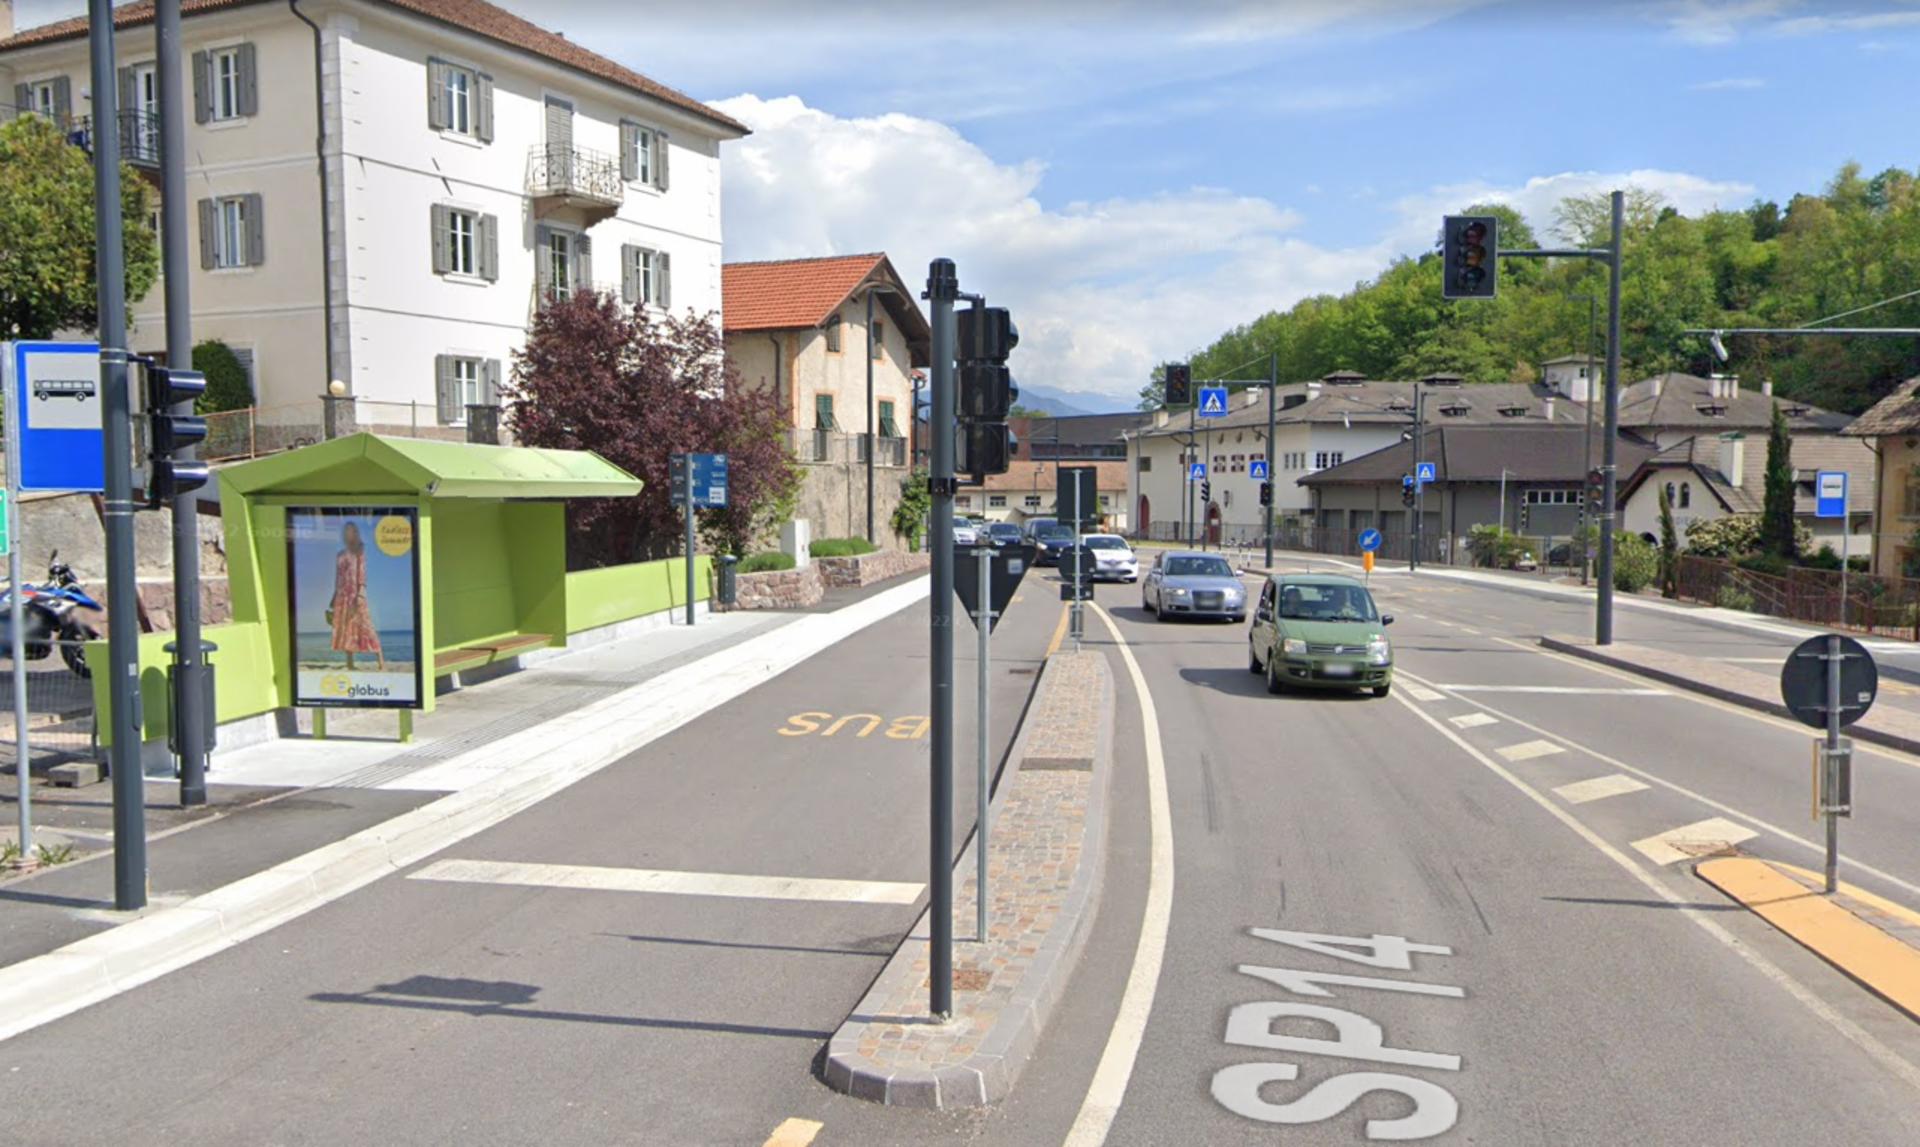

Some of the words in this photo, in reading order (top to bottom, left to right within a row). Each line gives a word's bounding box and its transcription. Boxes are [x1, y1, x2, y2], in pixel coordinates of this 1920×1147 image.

[347, 684, 390, 698] globus
[776, 711, 932, 740] BUS
[1210, 926, 1466, 1140] SP14
